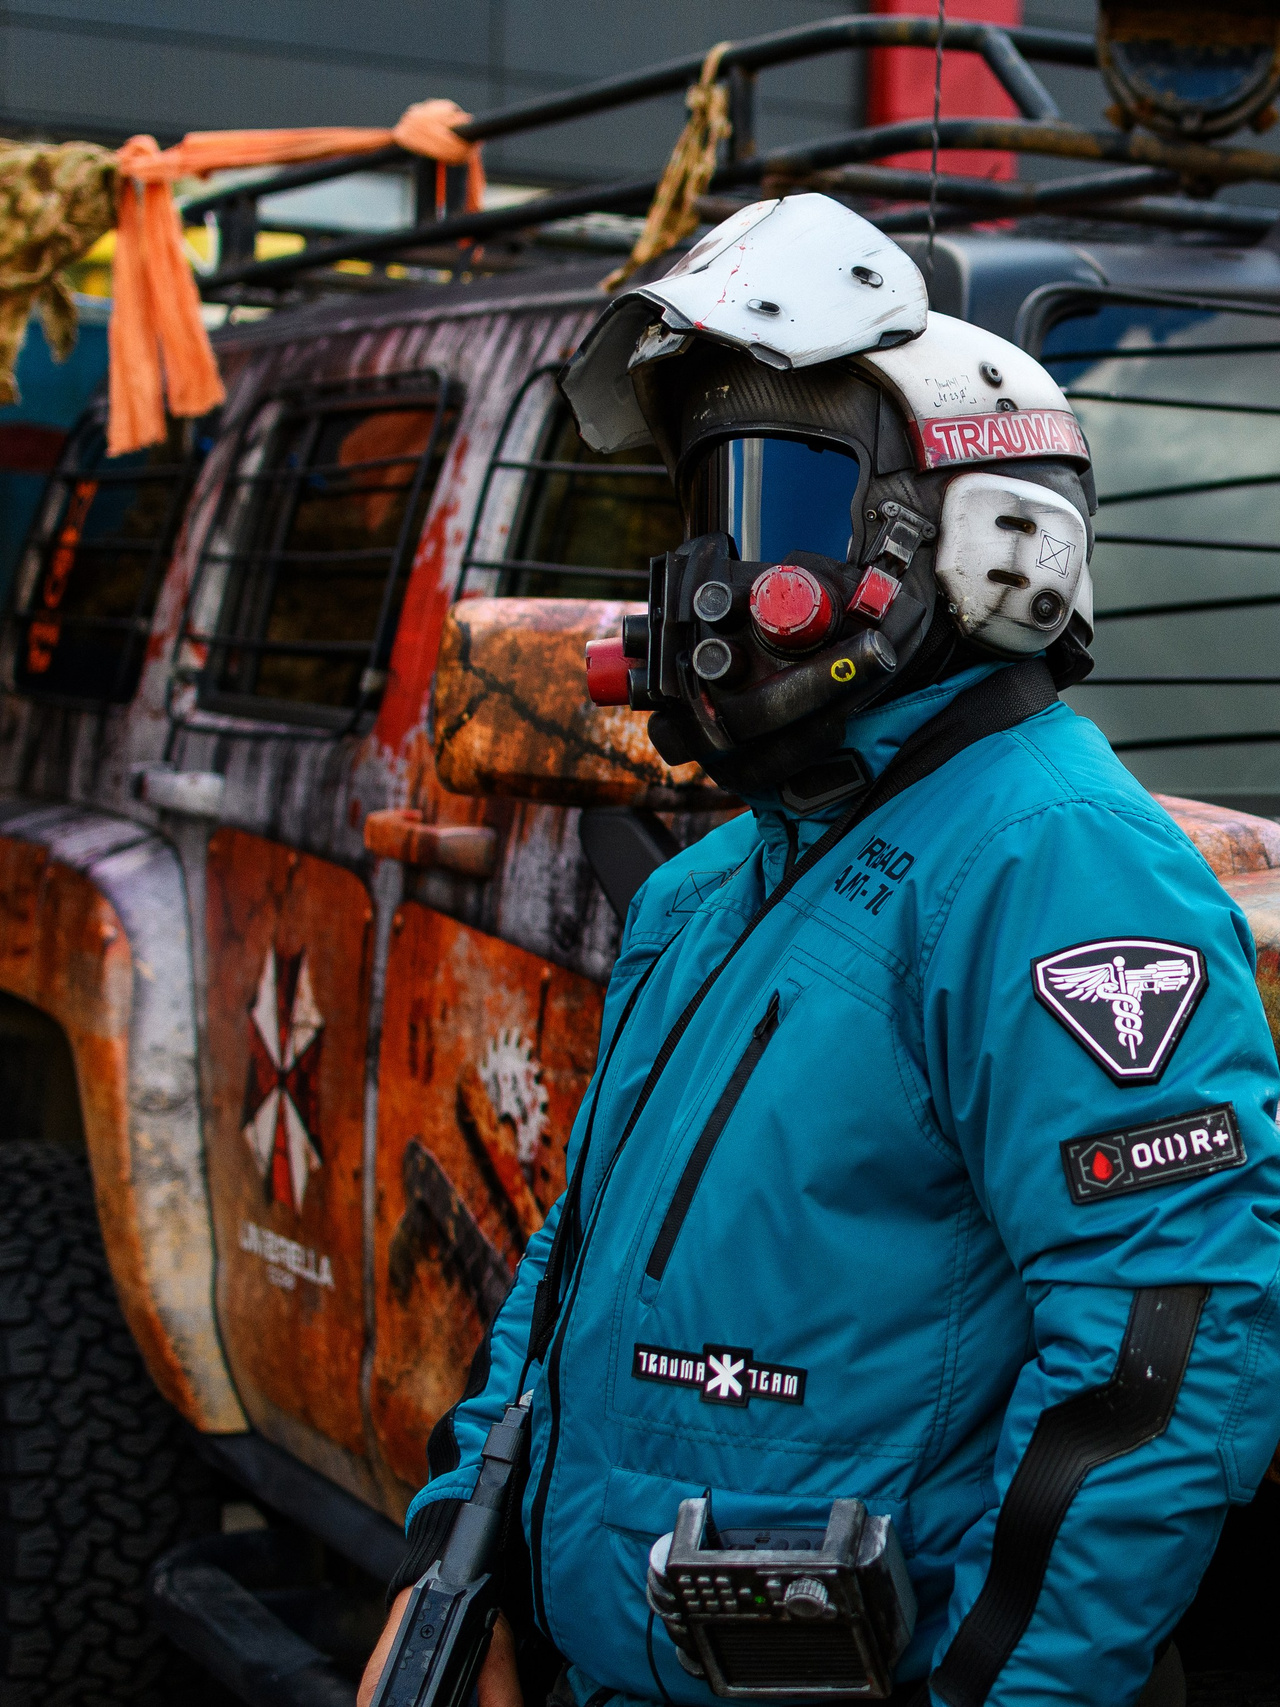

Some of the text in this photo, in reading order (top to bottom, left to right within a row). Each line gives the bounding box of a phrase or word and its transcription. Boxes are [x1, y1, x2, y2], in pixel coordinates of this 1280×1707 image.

[932, 415, 1070, 461] TRAUMA
[638, 1351, 799, 1396] TRAUMA TEAM
